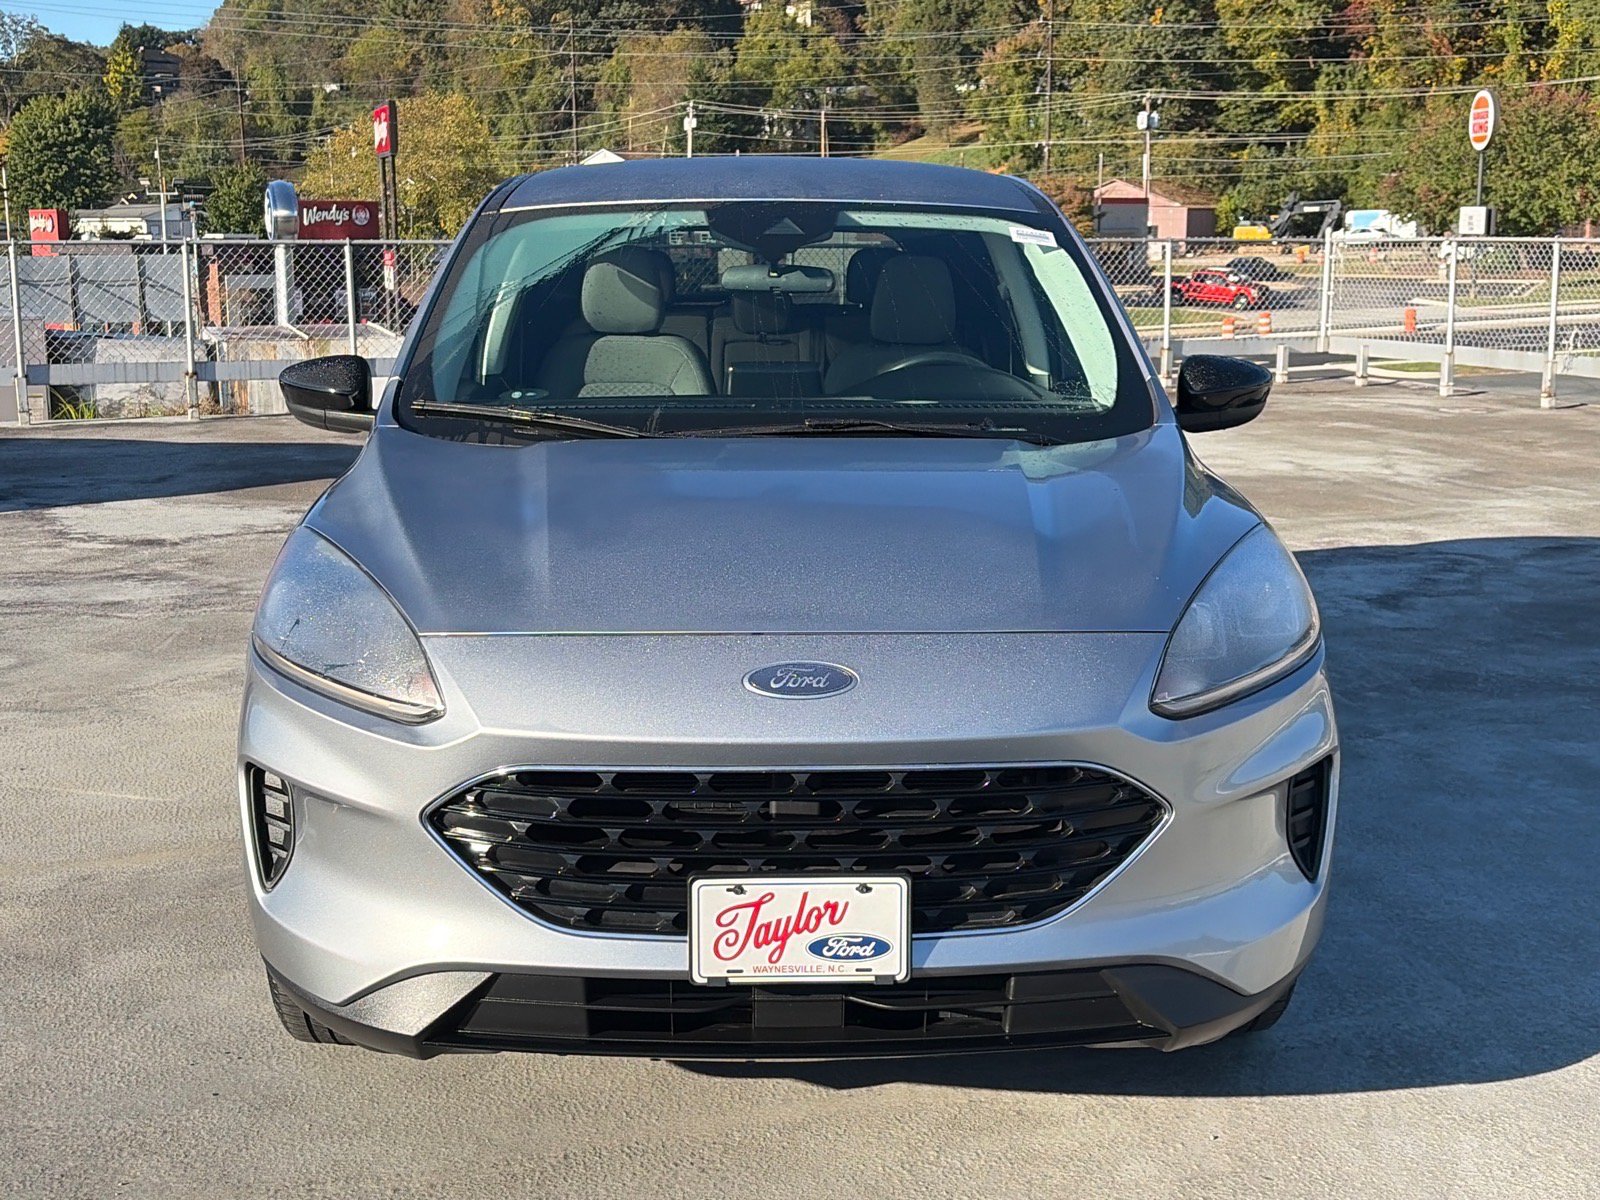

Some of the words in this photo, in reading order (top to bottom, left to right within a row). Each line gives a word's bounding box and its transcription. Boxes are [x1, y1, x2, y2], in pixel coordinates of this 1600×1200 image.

[302, 203, 350, 226] Wendy's
[769, 667, 831, 690] Ford
[713, 891, 849, 964] Taylor
[822, 935, 876, 957] Ford
[752, 965, 826, 974] WAYNESVILLE,
